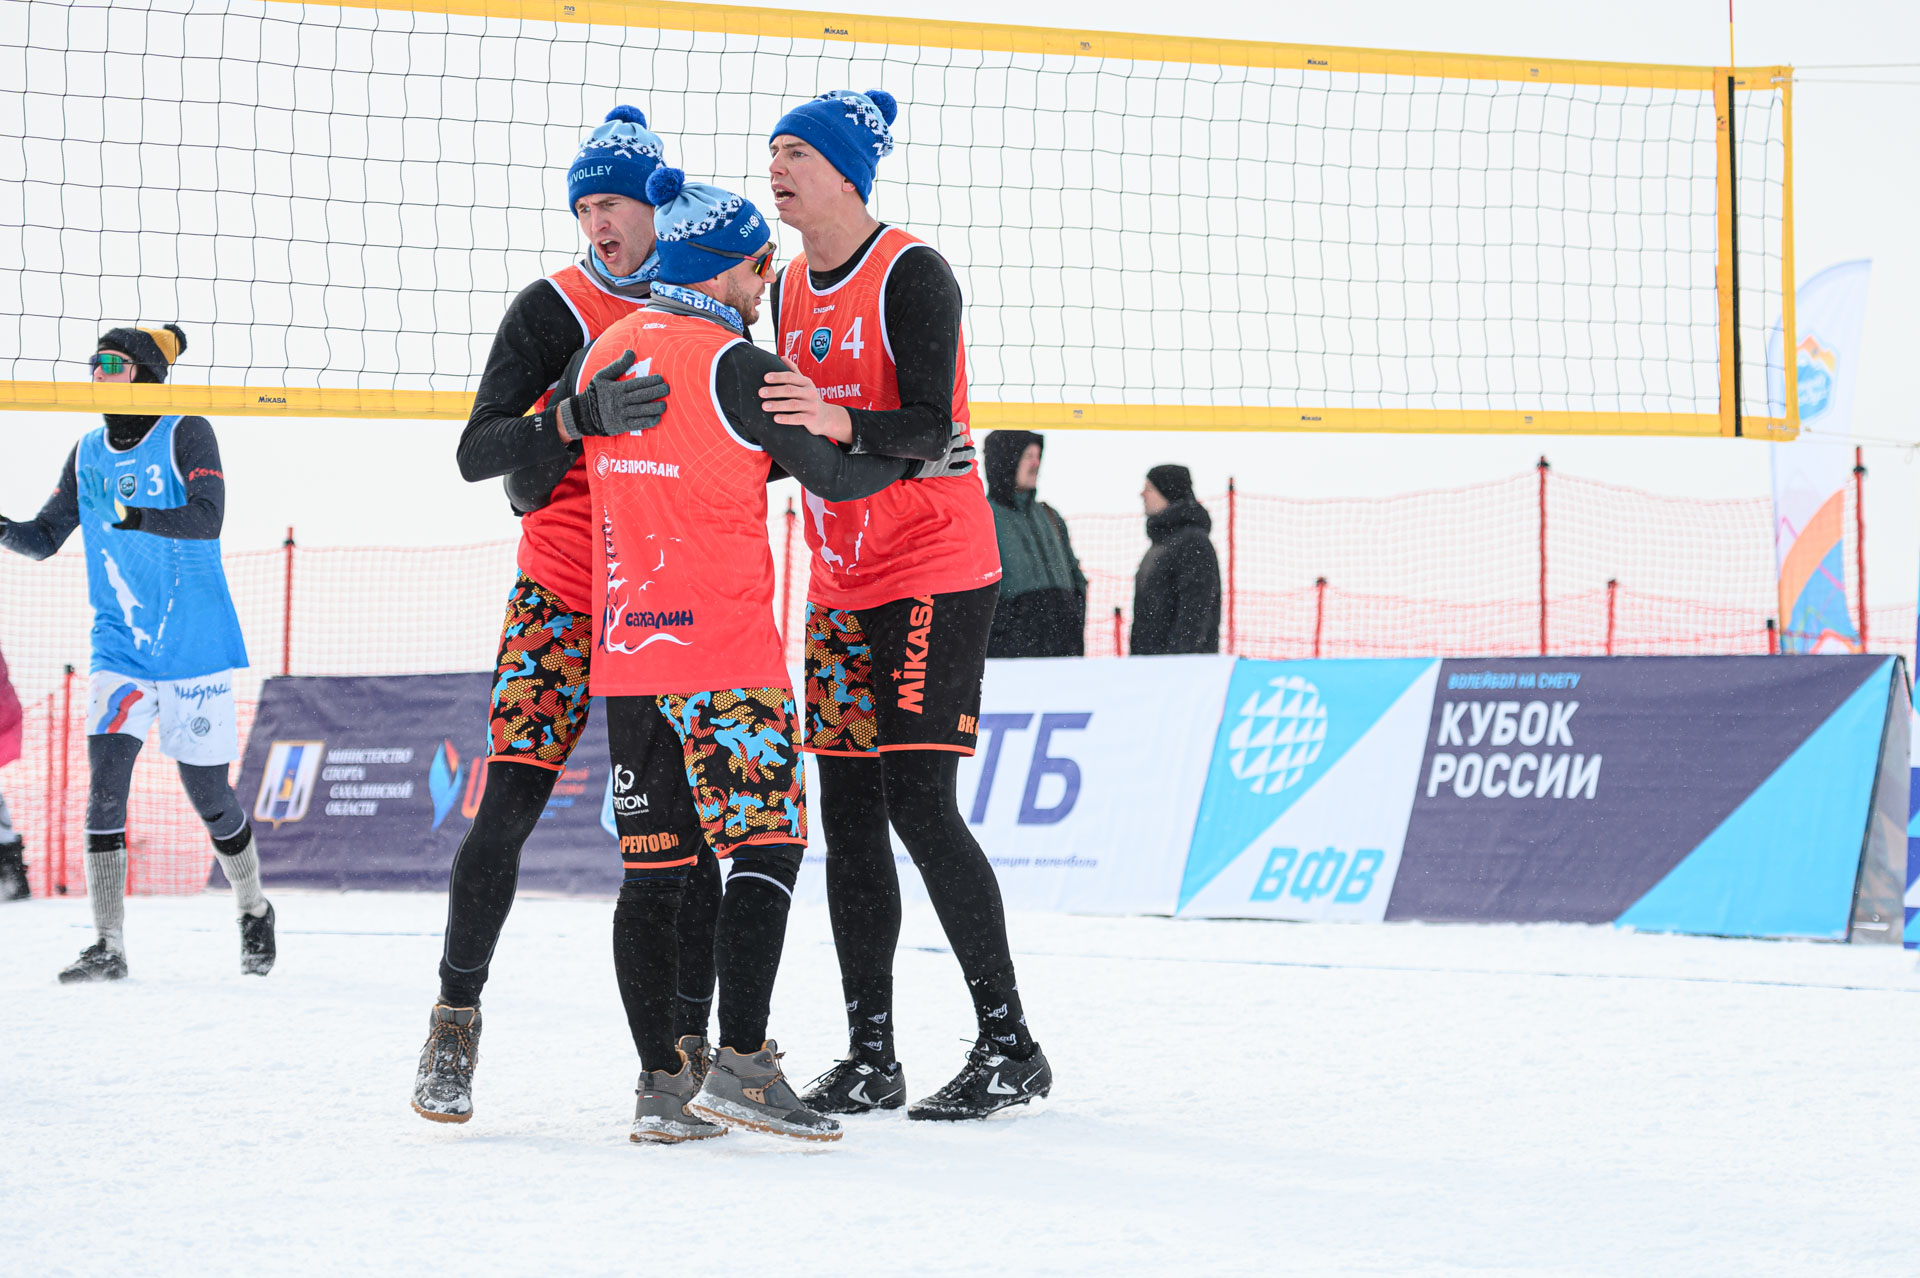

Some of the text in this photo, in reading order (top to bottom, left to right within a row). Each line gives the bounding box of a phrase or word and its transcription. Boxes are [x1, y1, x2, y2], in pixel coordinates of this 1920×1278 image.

[840, 316, 865, 360] 4
[258, 395, 287, 404] MIKASA
[145, 463, 164, 497] 3
[1447, 671, 1581, 690] ВОЛЕЙБОЛ НА СНЕГУ
[1436, 700, 1580, 747] КУБОК
[1426, 752, 1602, 800] РОССИИ
[1249, 846, 1386, 904] ВФВ
